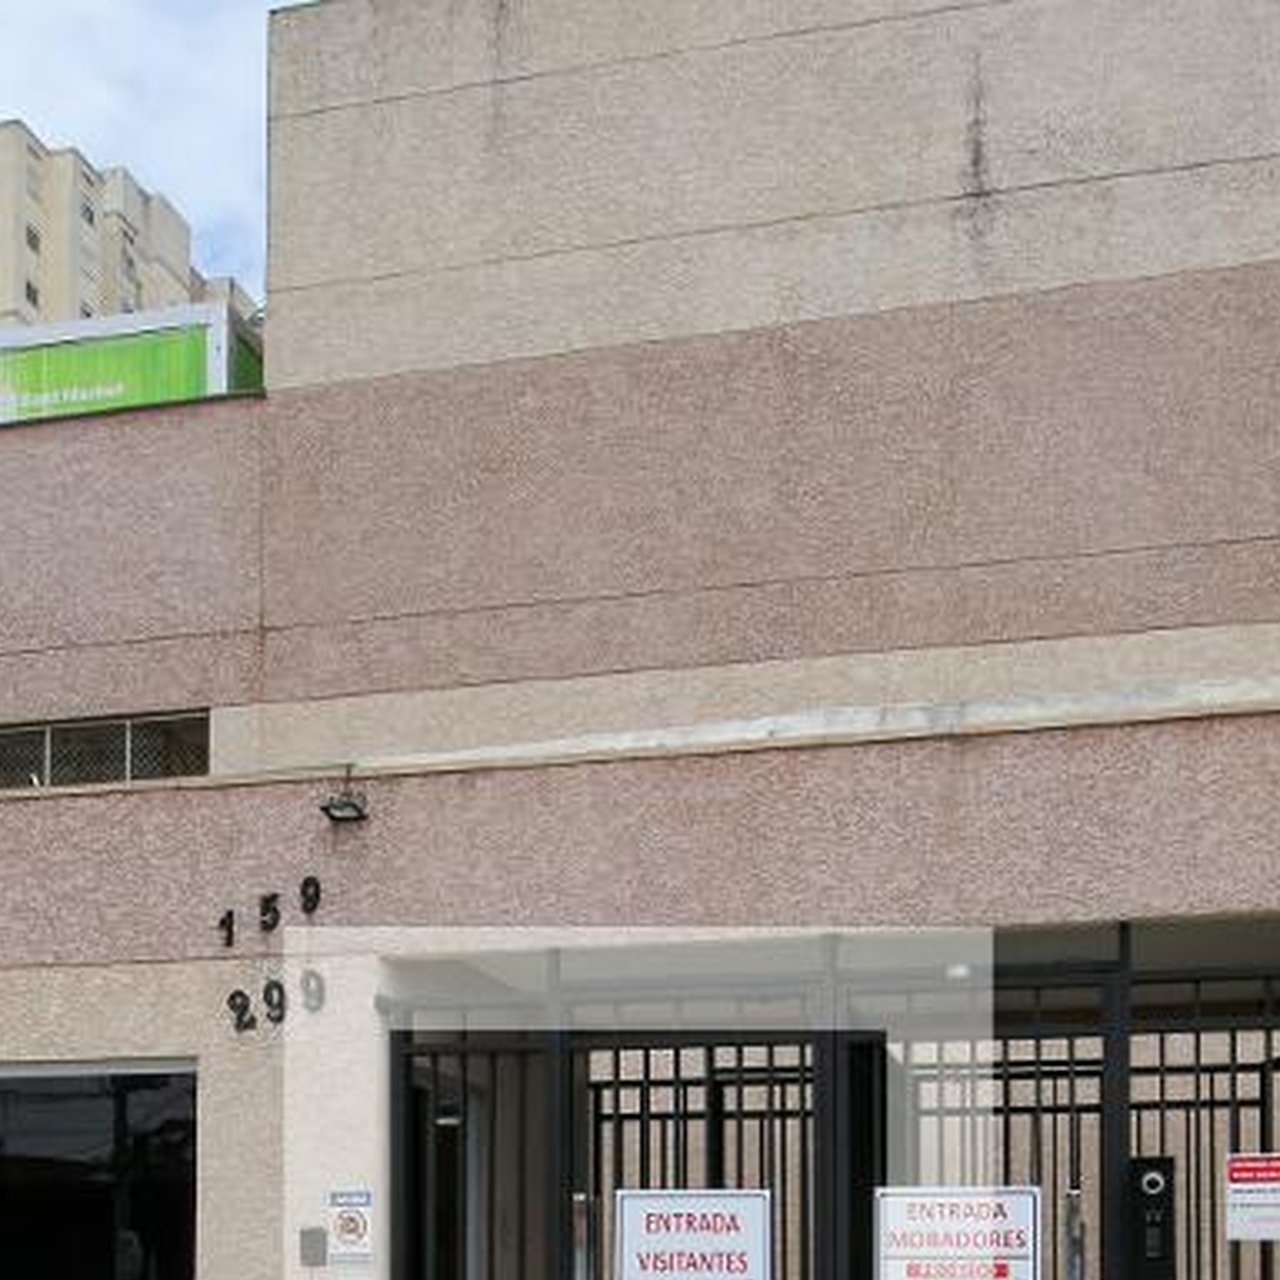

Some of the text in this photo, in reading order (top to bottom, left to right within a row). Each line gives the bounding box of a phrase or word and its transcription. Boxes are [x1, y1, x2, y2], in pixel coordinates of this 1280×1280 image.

[219, 876, 321, 948] 159
[227, 968, 326, 1033] 299
[906, 1201, 1008, 1221] ENTRADA
[645, 1212, 740, 1235] ENTRADA
[888, 1229, 1027, 1249] MORADORES
[637, 1252, 748, 1276] VISITANTES
